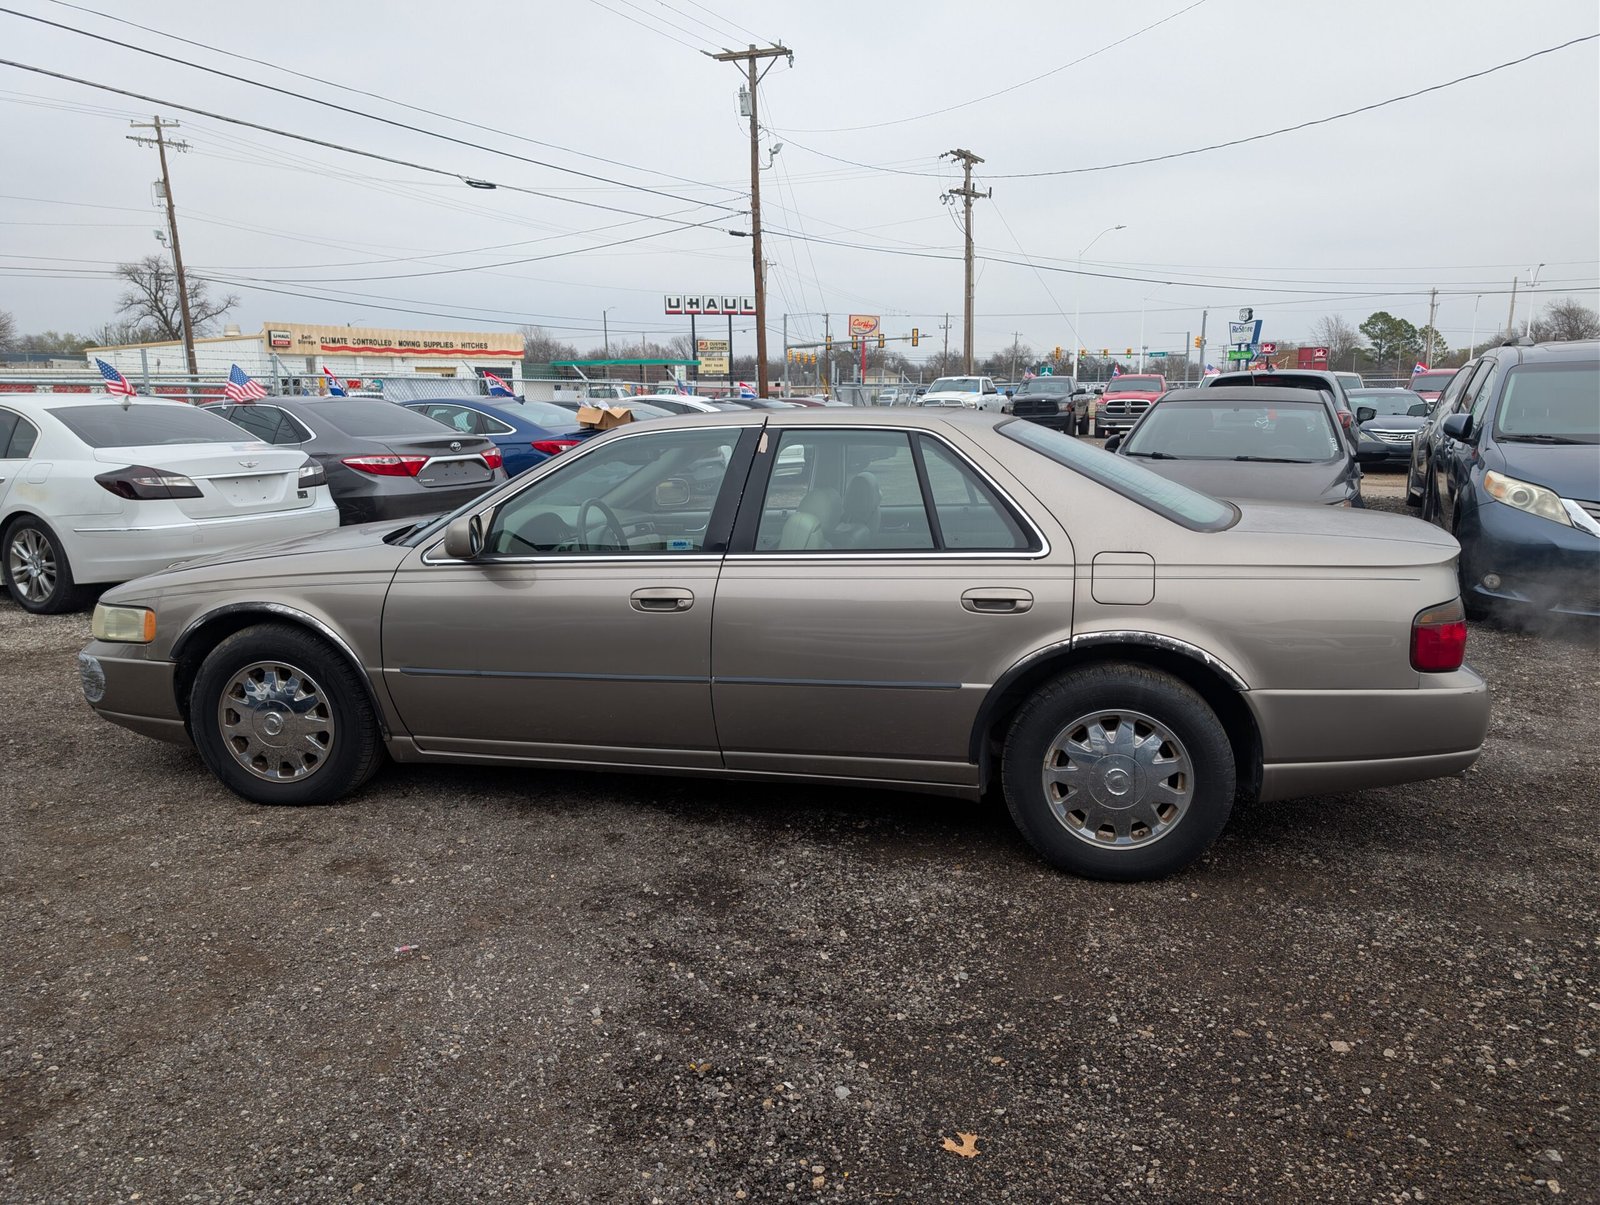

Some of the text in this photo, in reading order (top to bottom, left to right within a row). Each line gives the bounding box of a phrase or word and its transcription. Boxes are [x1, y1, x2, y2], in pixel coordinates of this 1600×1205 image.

[320, 336, 488, 350] CLIMATE CONTROLLED MOVING SUPPLIES HITCHES
